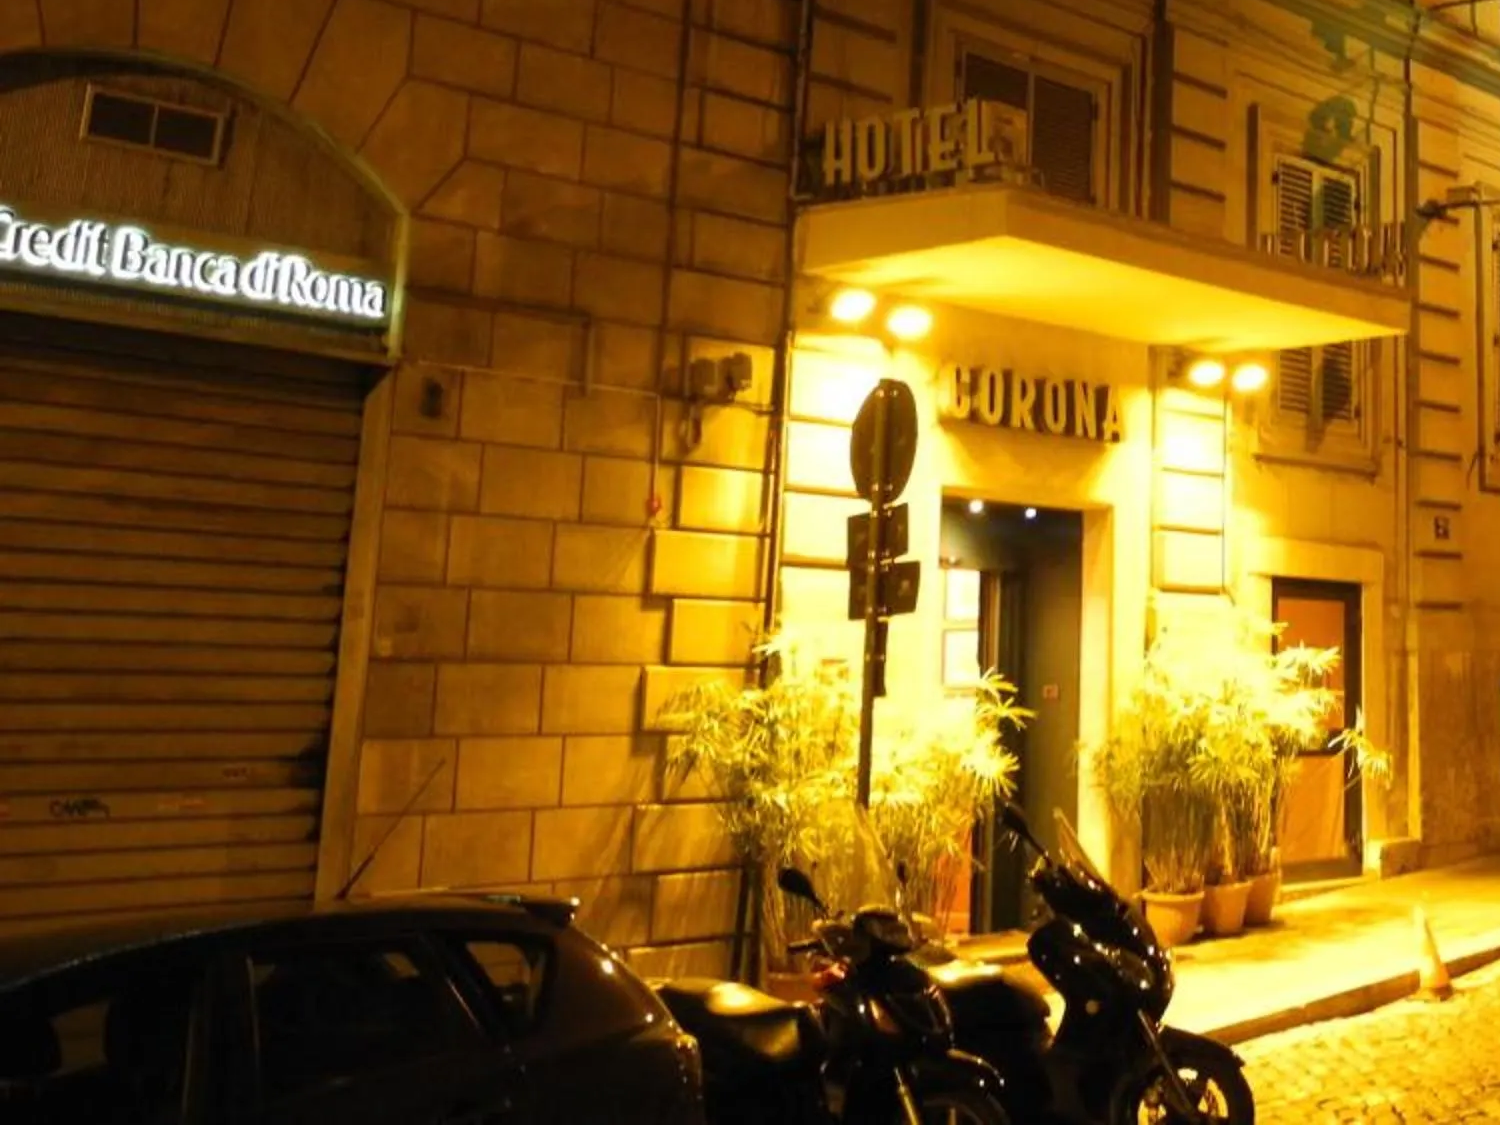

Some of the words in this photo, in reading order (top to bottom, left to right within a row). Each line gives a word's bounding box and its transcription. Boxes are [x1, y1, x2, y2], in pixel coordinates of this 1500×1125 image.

[823, 97, 997, 188] HOTEL
[112, 225, 240, 297] Banca
[275, 254, 388, 318] Roma
[950, 362, 1123, 444] CORONA
